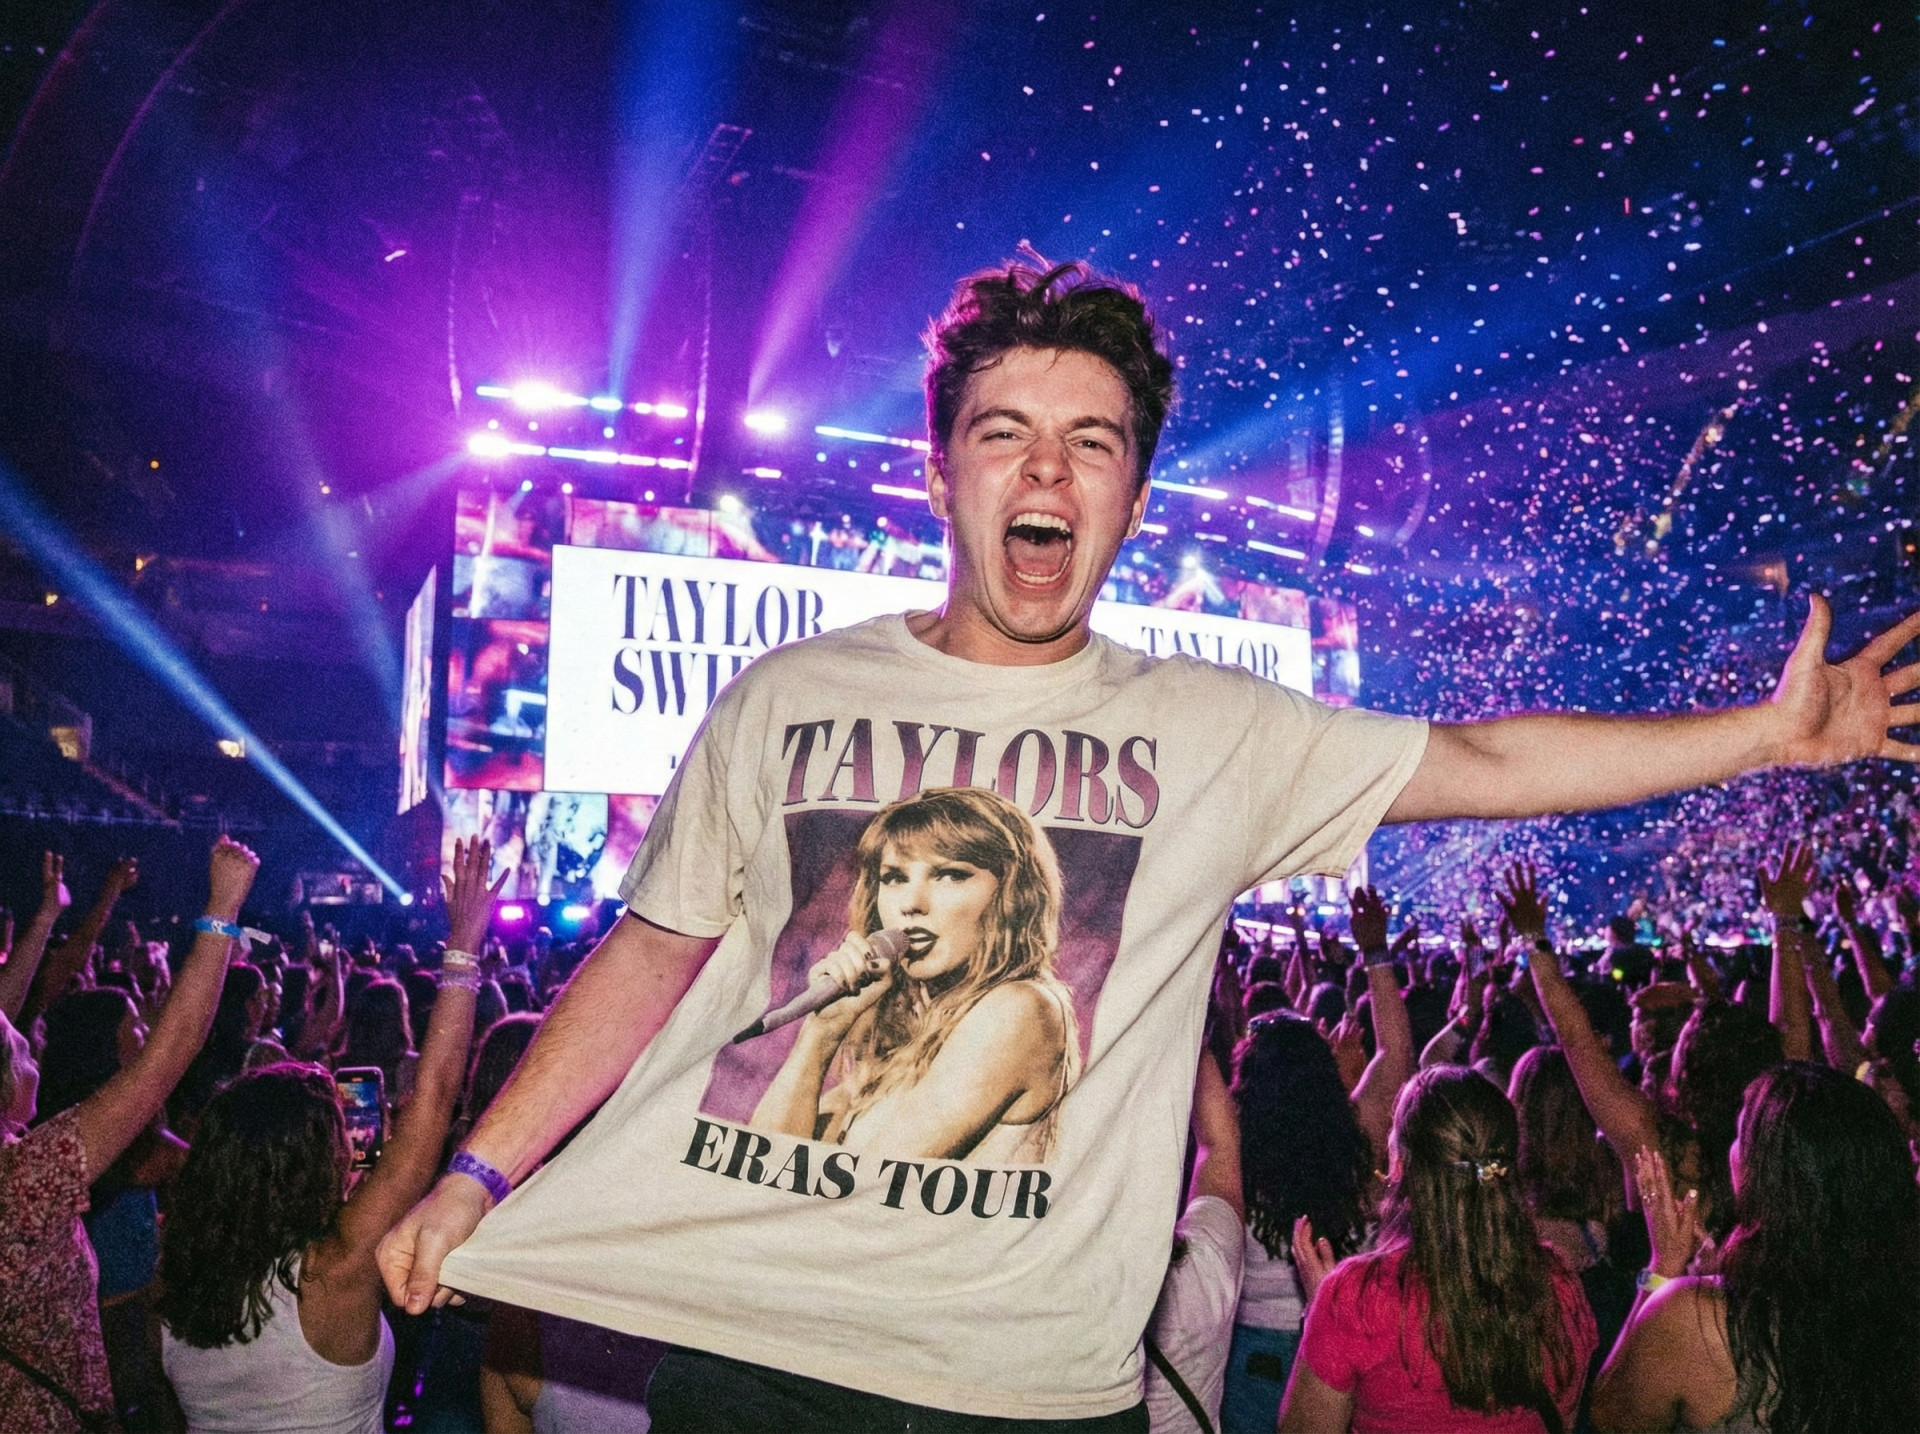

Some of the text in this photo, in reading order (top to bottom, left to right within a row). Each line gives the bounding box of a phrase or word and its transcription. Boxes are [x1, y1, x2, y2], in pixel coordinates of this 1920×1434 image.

[613, 574, 824, 649] TAYLOR
[612, 646, 754, 716] SWI
[781, 718, 1160, 829] TAYLORS
[679, 1117, 1053, 1220] ERAS TOUR
